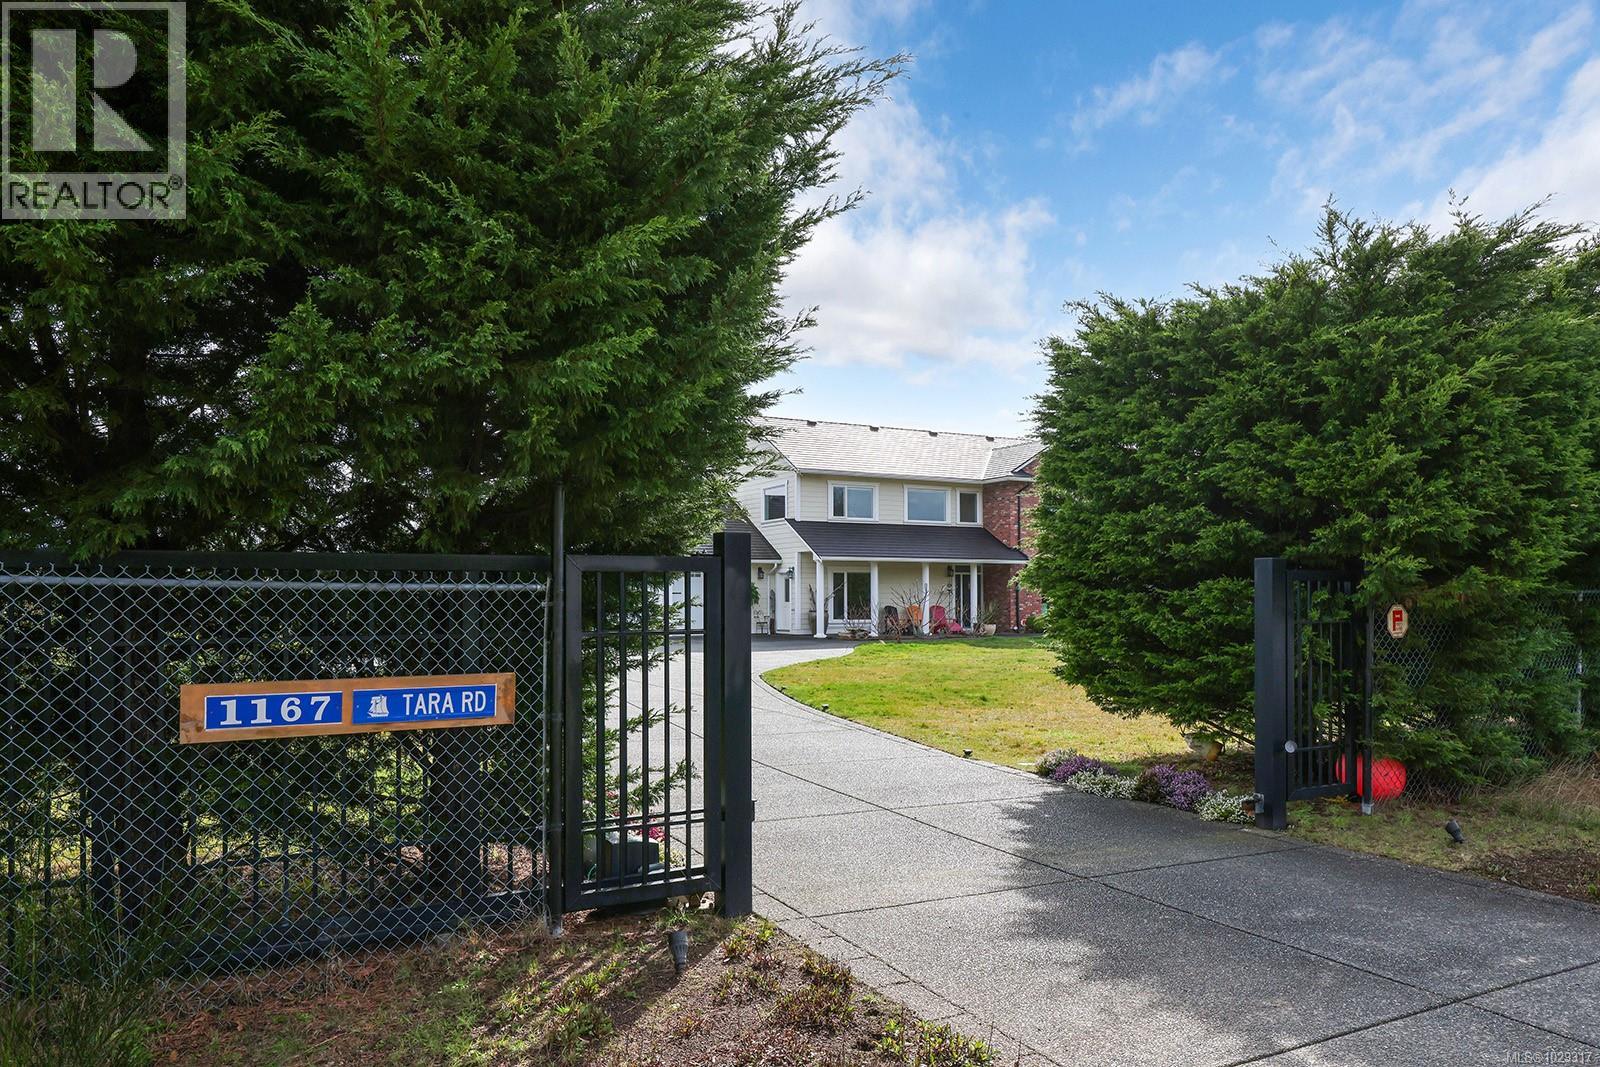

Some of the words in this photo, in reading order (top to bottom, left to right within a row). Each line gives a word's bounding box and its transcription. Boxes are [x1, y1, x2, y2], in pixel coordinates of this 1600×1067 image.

[219, 695, 331, 726] 1167
[402, 691, 454, 716] TARA
[461, 690, 487, 714] RD
